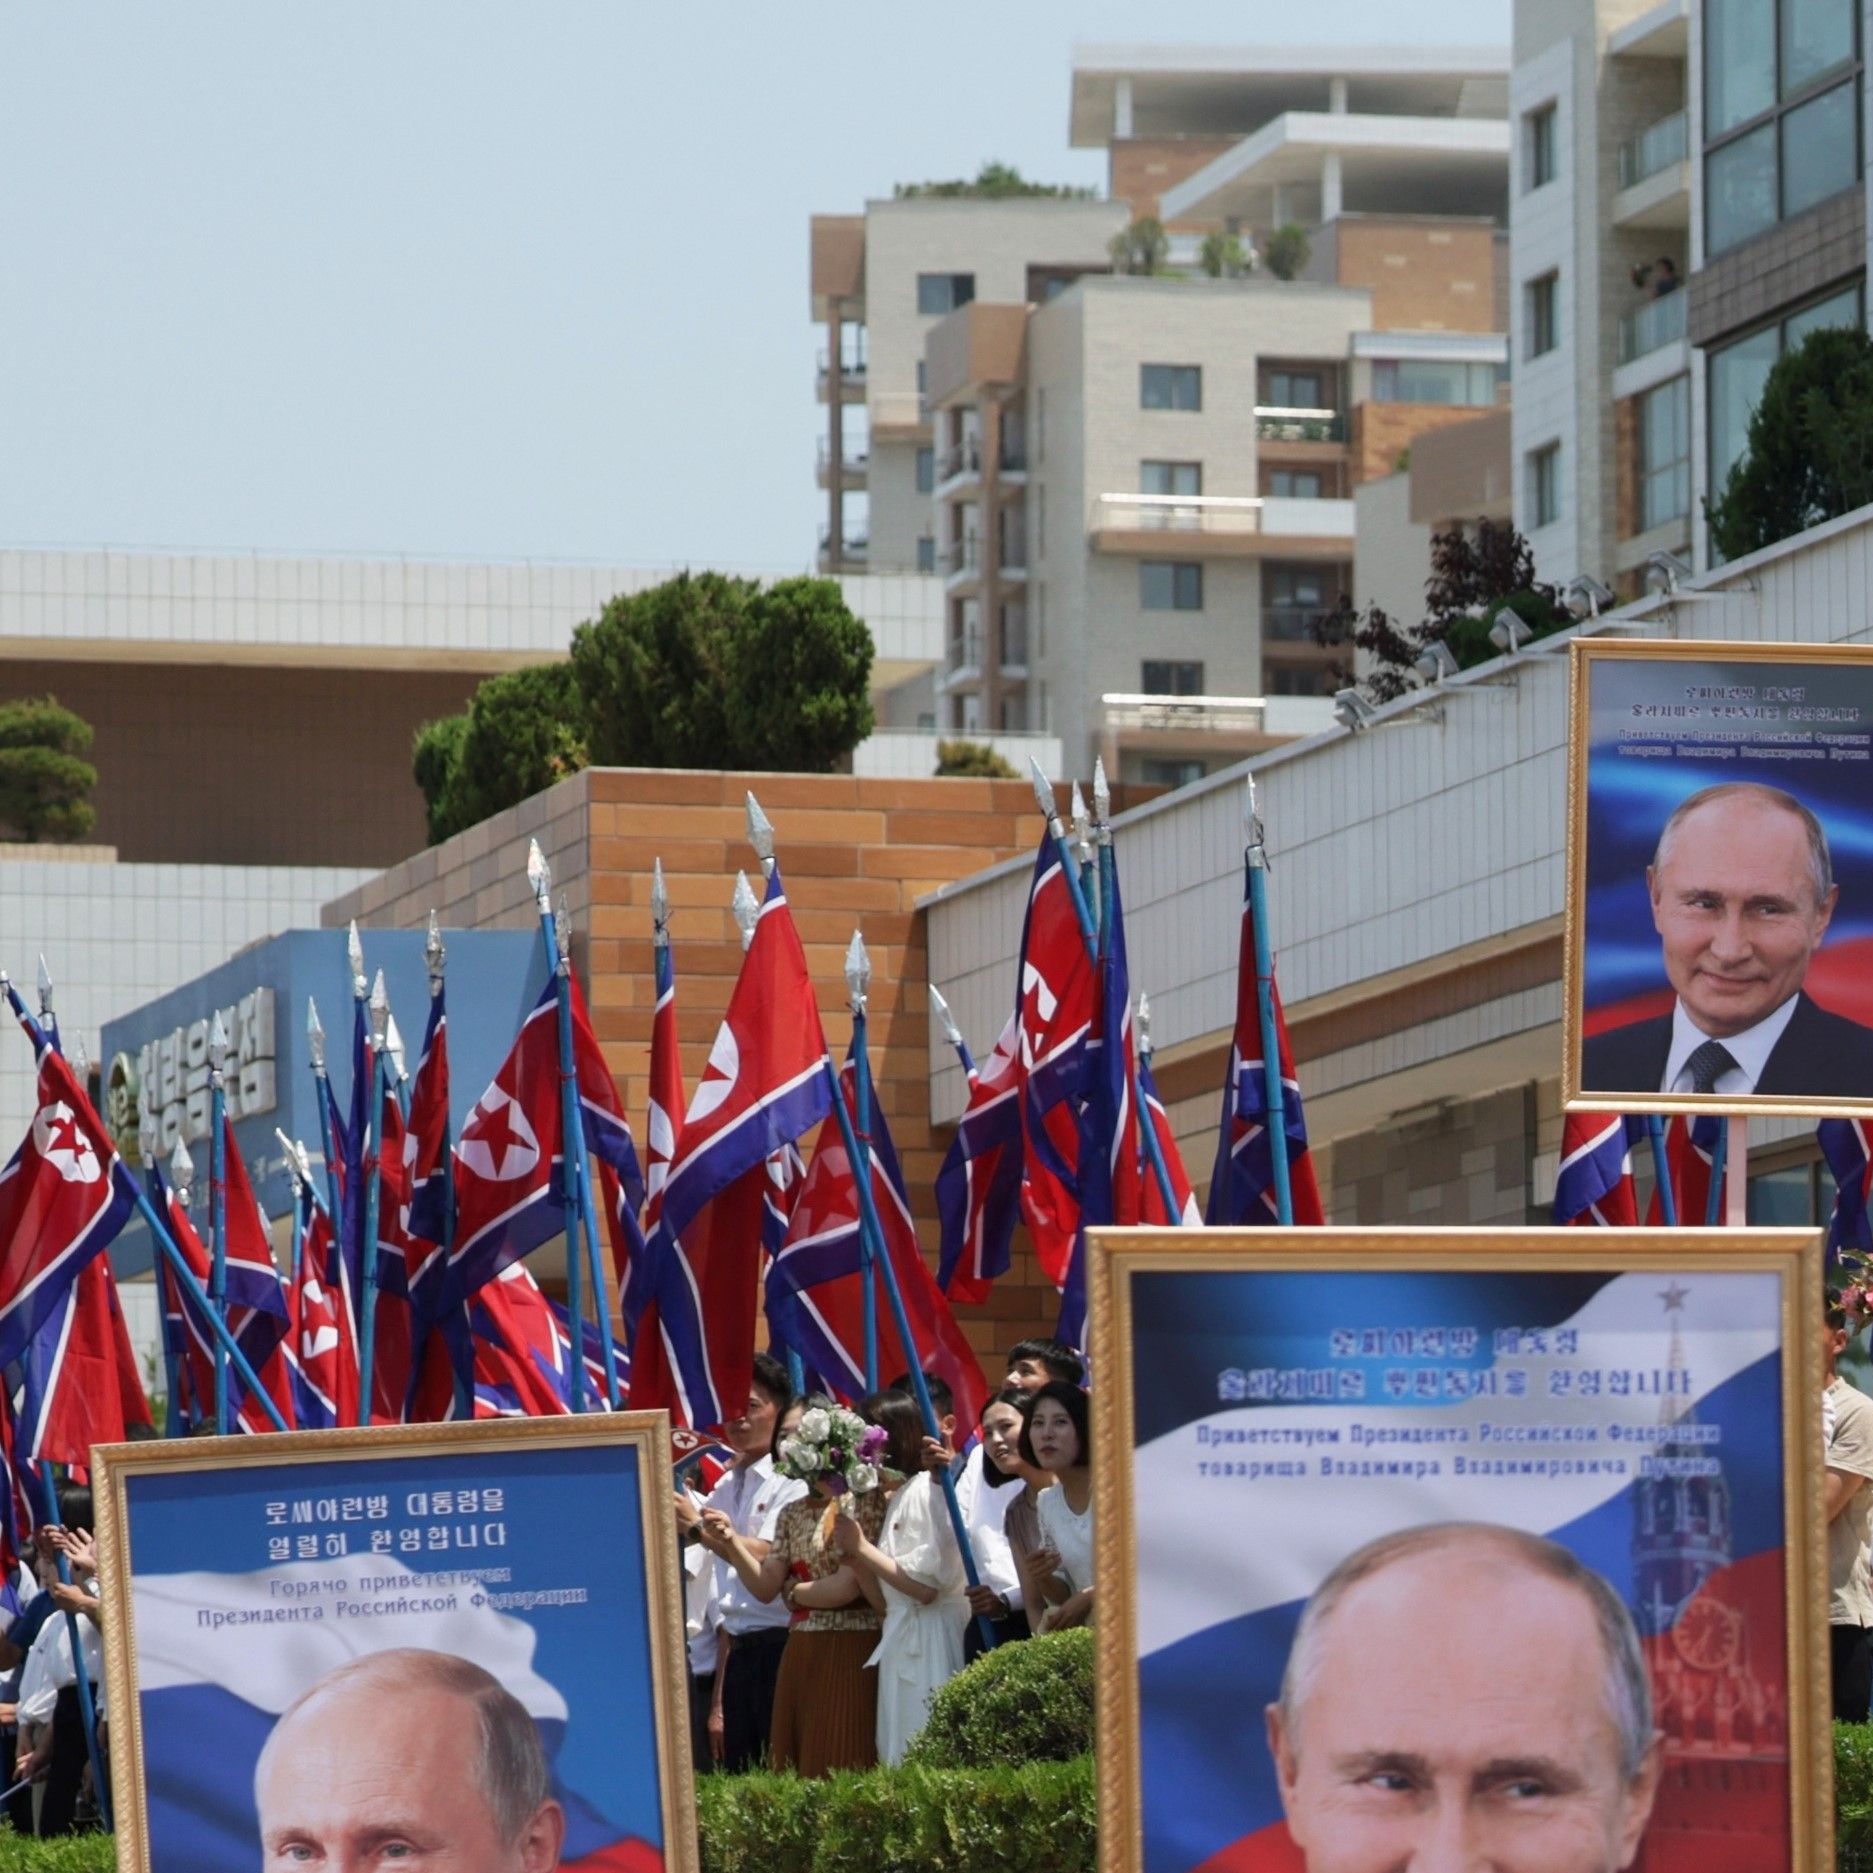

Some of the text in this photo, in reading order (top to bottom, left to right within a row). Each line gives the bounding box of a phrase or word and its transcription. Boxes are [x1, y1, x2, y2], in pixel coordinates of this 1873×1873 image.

[1197, 1422, 1721, 1447] Приветствуем Президента Российской Федерации
[1198, 1454, 1721, 1480] товарища Владимира Владимировича Путина
[406, 1488, 505, 1516] 대통령을
[268, 1522, 507, 1561] 열렬히 환영합니다
[270, 1566, 512, 1599] Горячо приветствуем
[197, 1587, 588, 1631] Президента Российской Федерации
